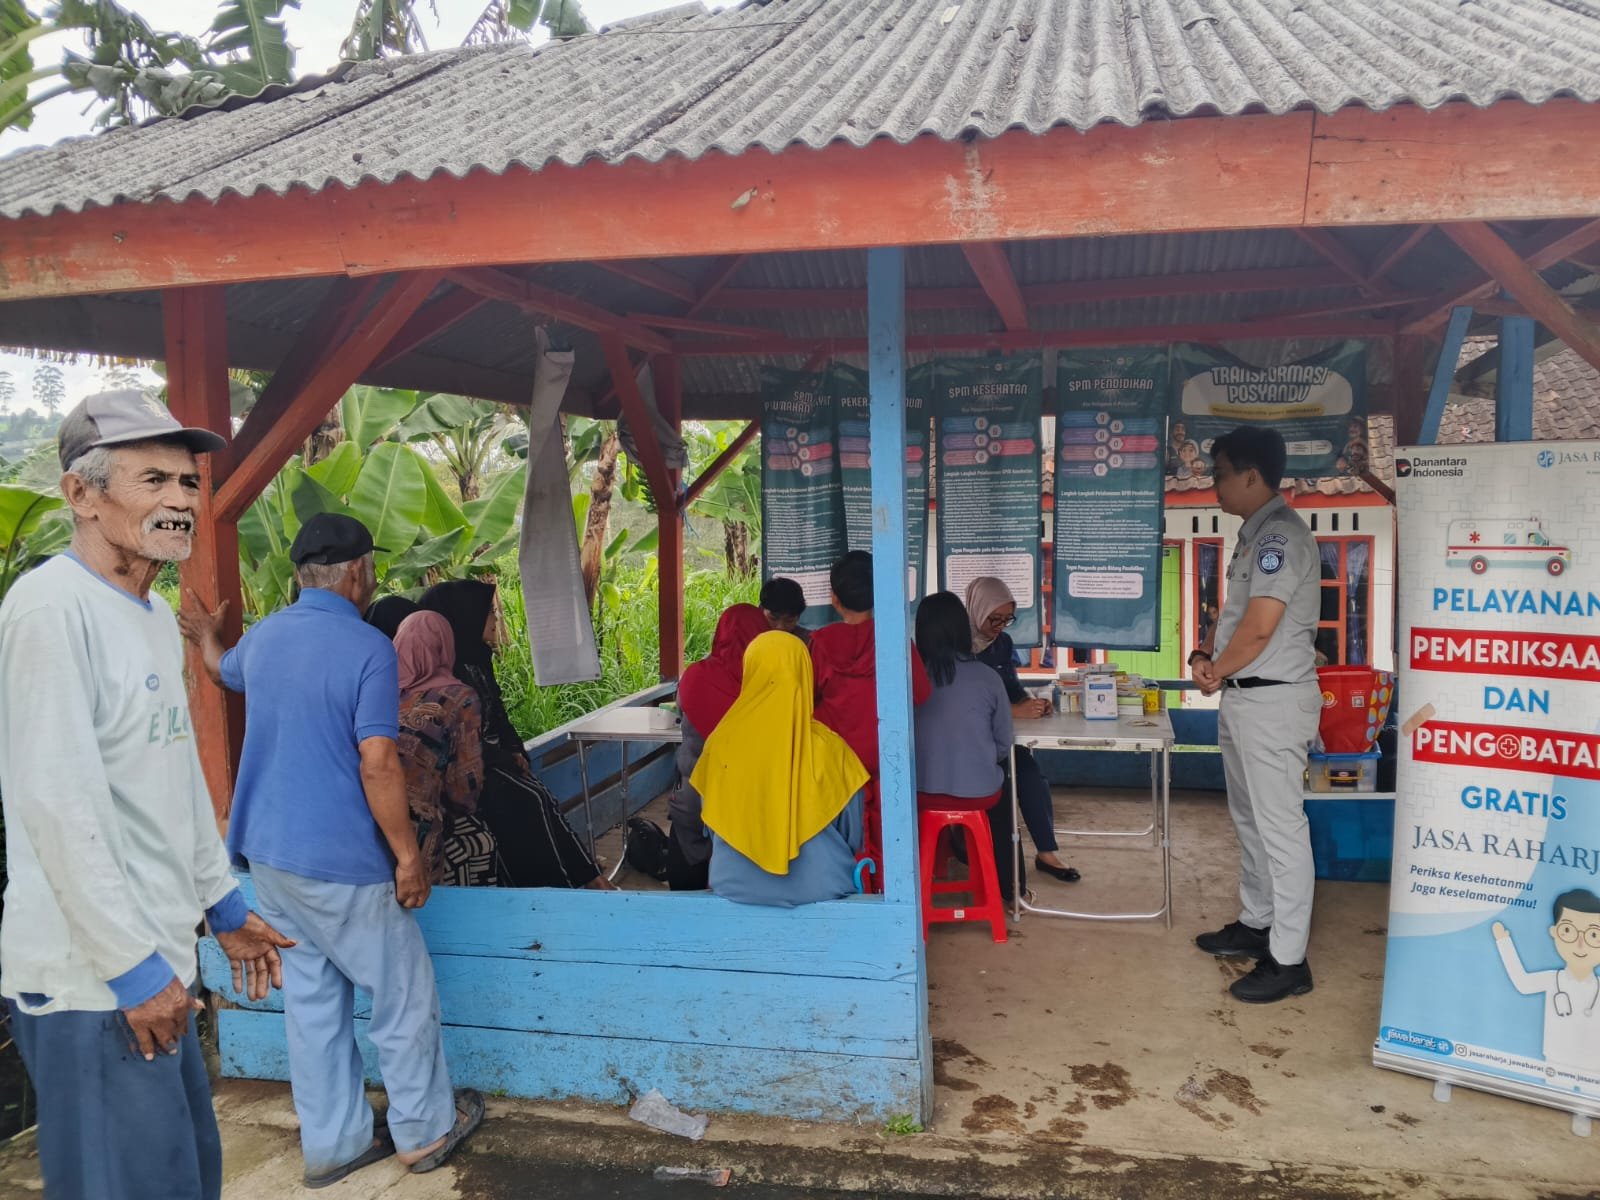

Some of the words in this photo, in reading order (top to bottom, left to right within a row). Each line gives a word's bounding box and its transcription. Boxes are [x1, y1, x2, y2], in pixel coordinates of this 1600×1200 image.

[948, 386, 970, 399] SPM
[973, 383, 1028, 395] KESEHATAN
[1068, 379, 1091, 392] SPM
[1094, 378, 1154, 390] PENDIDIKAN
[1228, 384, 1312, 403] POSYANDU
[1413, 457, 1467, 466] Danantara
[1558, 449, 1588, 464] JASA
[1413, 467, 1463, 478] Indonesia
[1484, 686, 1549, 714] DAN
[1416, 727, 1600, 769] PENGOBATA
[1461, 786, 1567, 820] GRATIS
[1412, 825, 1474, 852] JASA
[1410, 864, 1451, 880] Periksa
[1454, 871, 1534, 891] Kesehatanmu
[1411, 882, 1437, 897] Jaga
[1439, 886, 1537, 909] Keselamatanmu!
